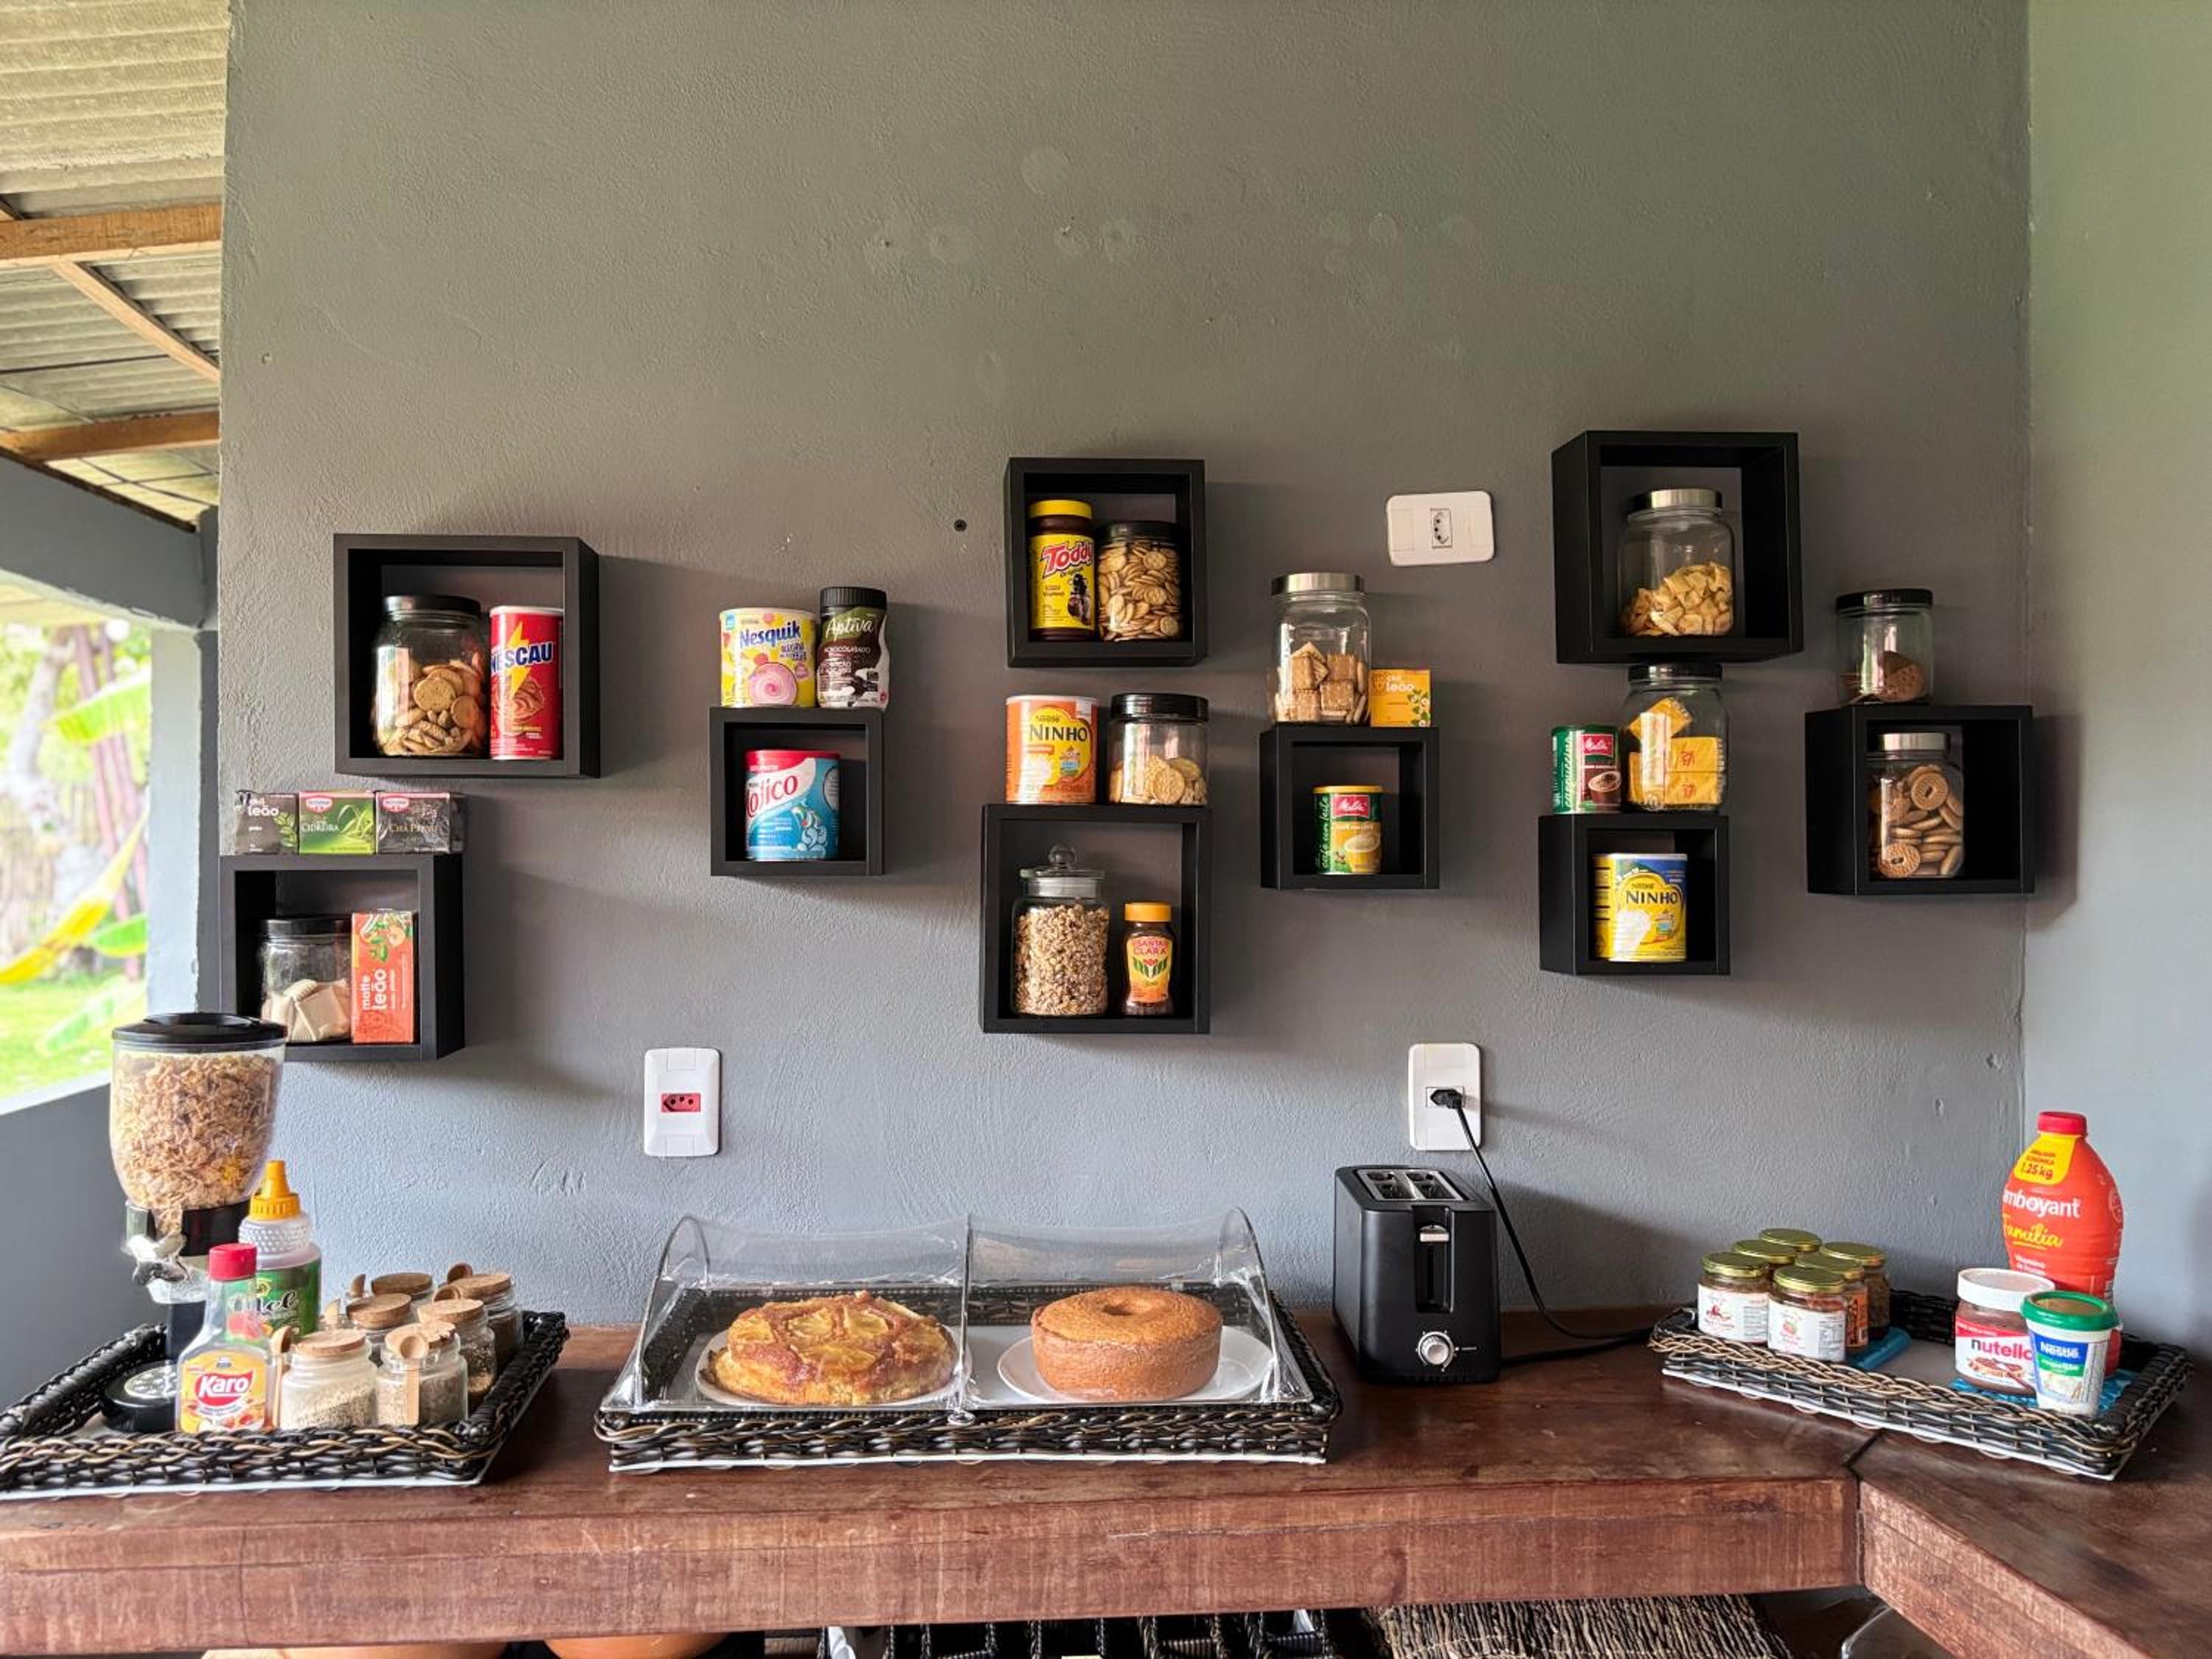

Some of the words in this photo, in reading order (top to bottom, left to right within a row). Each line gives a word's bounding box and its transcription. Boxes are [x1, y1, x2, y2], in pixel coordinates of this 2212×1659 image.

[740, 620, 801, 650] Nesquik
[1029, 724, 1088, 742] NINHO
[748, 775, 799, 818] olico
[1627, 890, 1679, 905] NINHO
[371, 967, 387, 1011] leão
[198, 1375, 249, 1398] Karo
